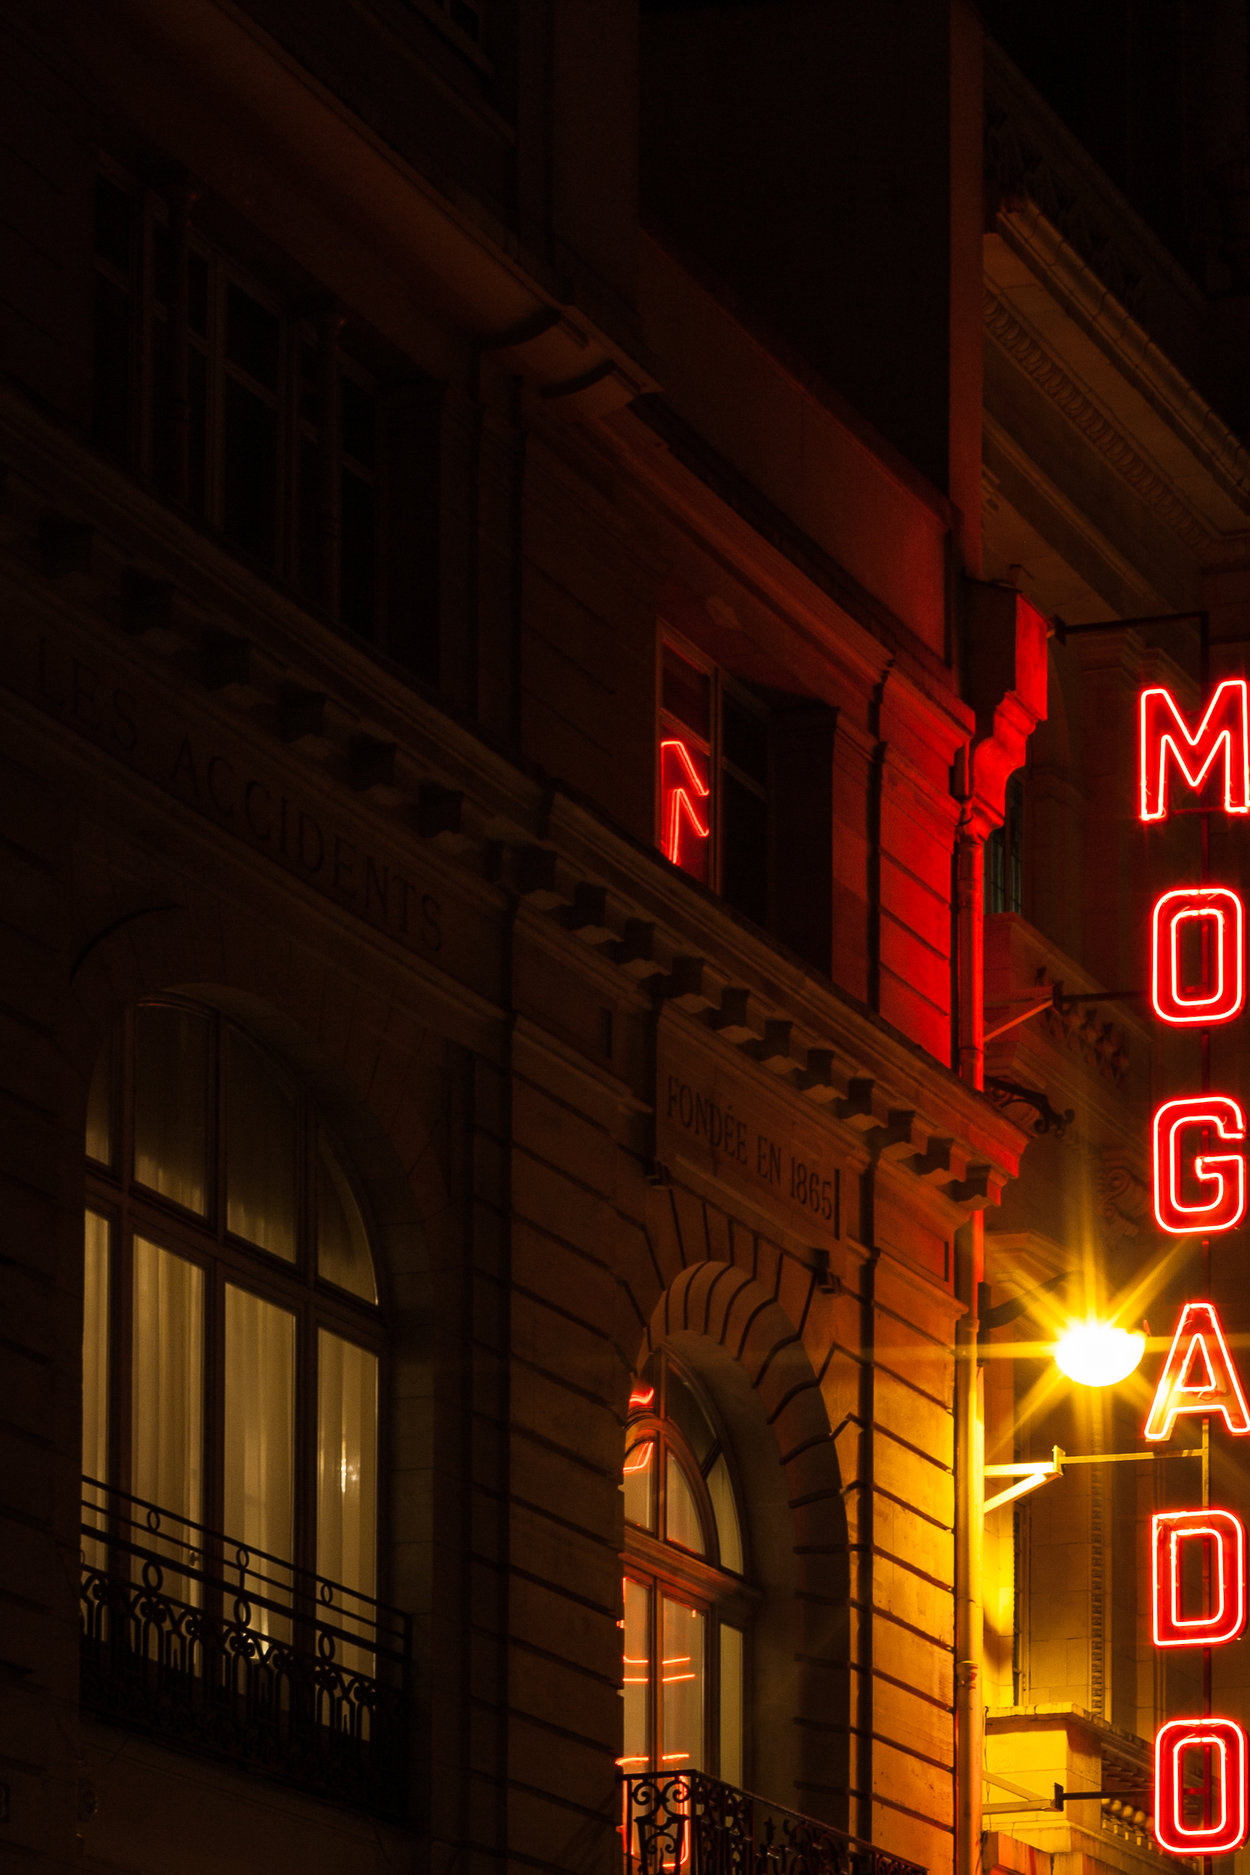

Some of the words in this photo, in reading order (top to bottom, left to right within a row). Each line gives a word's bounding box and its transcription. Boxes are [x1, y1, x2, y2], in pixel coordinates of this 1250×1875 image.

[38, 636, 139, 751] LES
[170, 732, 443, 953] ACCIDENTS
[666, 1075, 748, 1167] FONDÉE
[757, 1134, 782, 1187] EN
[789, 1156, 833, 1221] 1865
